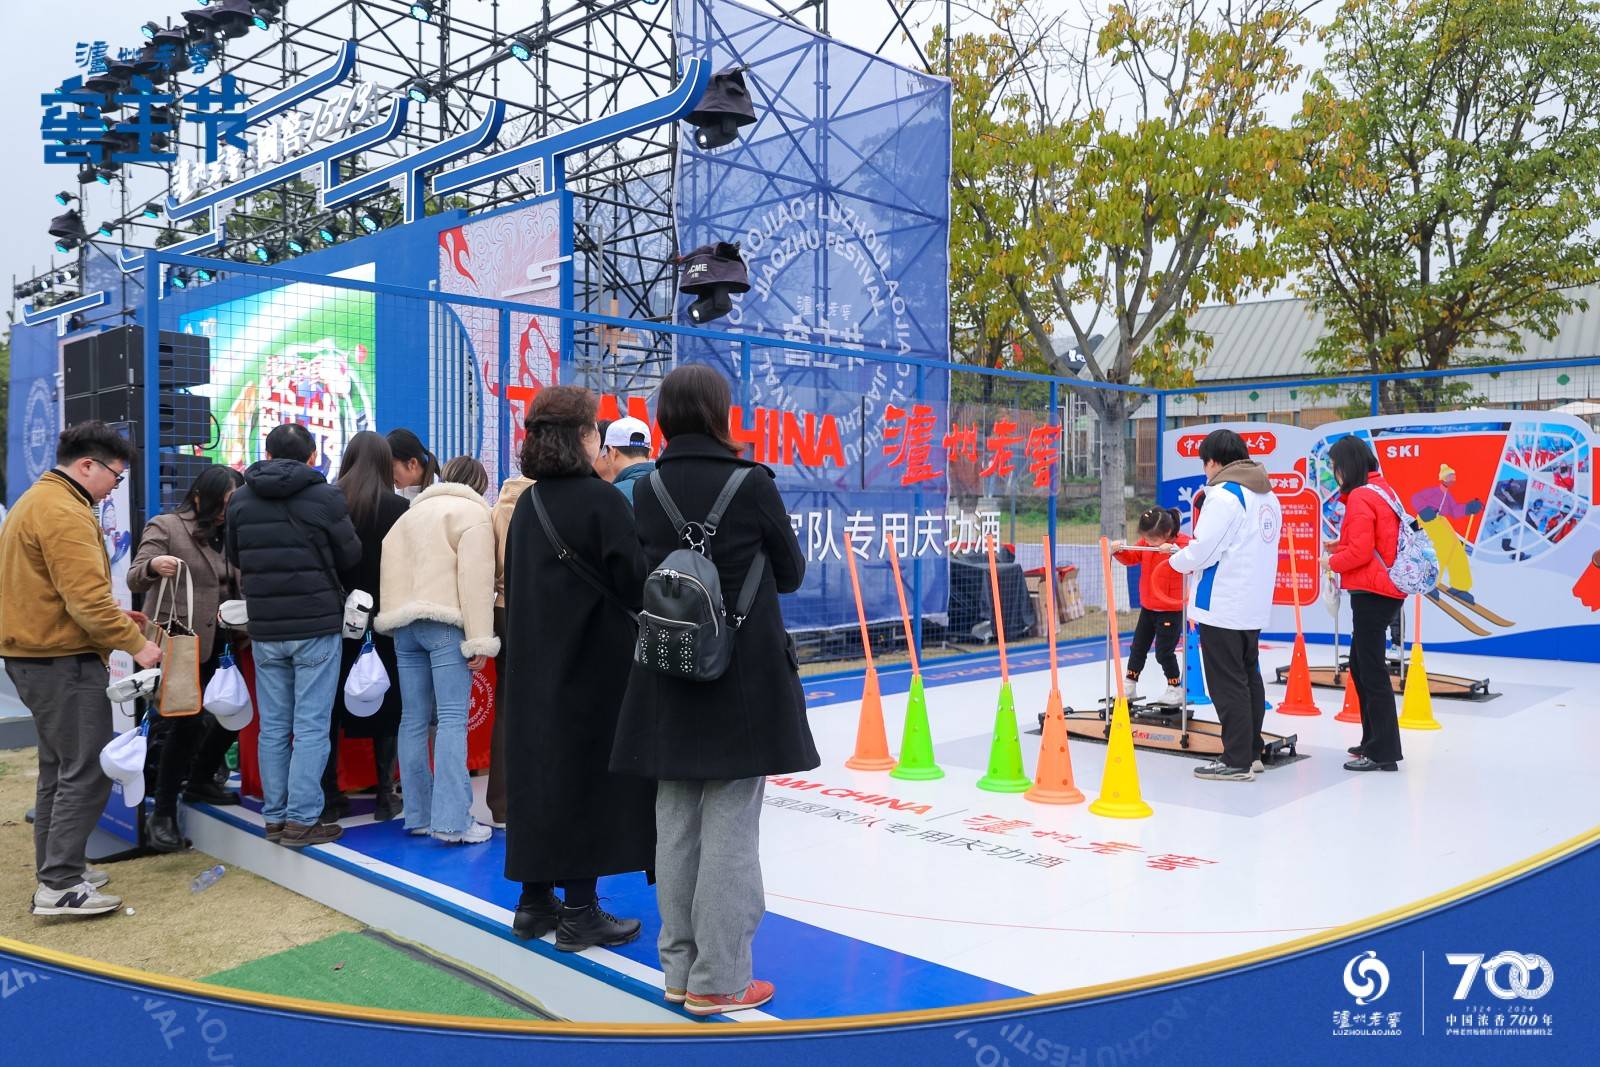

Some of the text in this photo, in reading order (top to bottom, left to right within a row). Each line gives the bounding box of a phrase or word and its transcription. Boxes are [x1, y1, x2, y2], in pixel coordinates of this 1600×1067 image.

[754, 229, 885, 317] JIAOZHU FESTIVAL
[1386, 443, 1421, 459] SKI
[820, 788, 934, 815] CHINA
